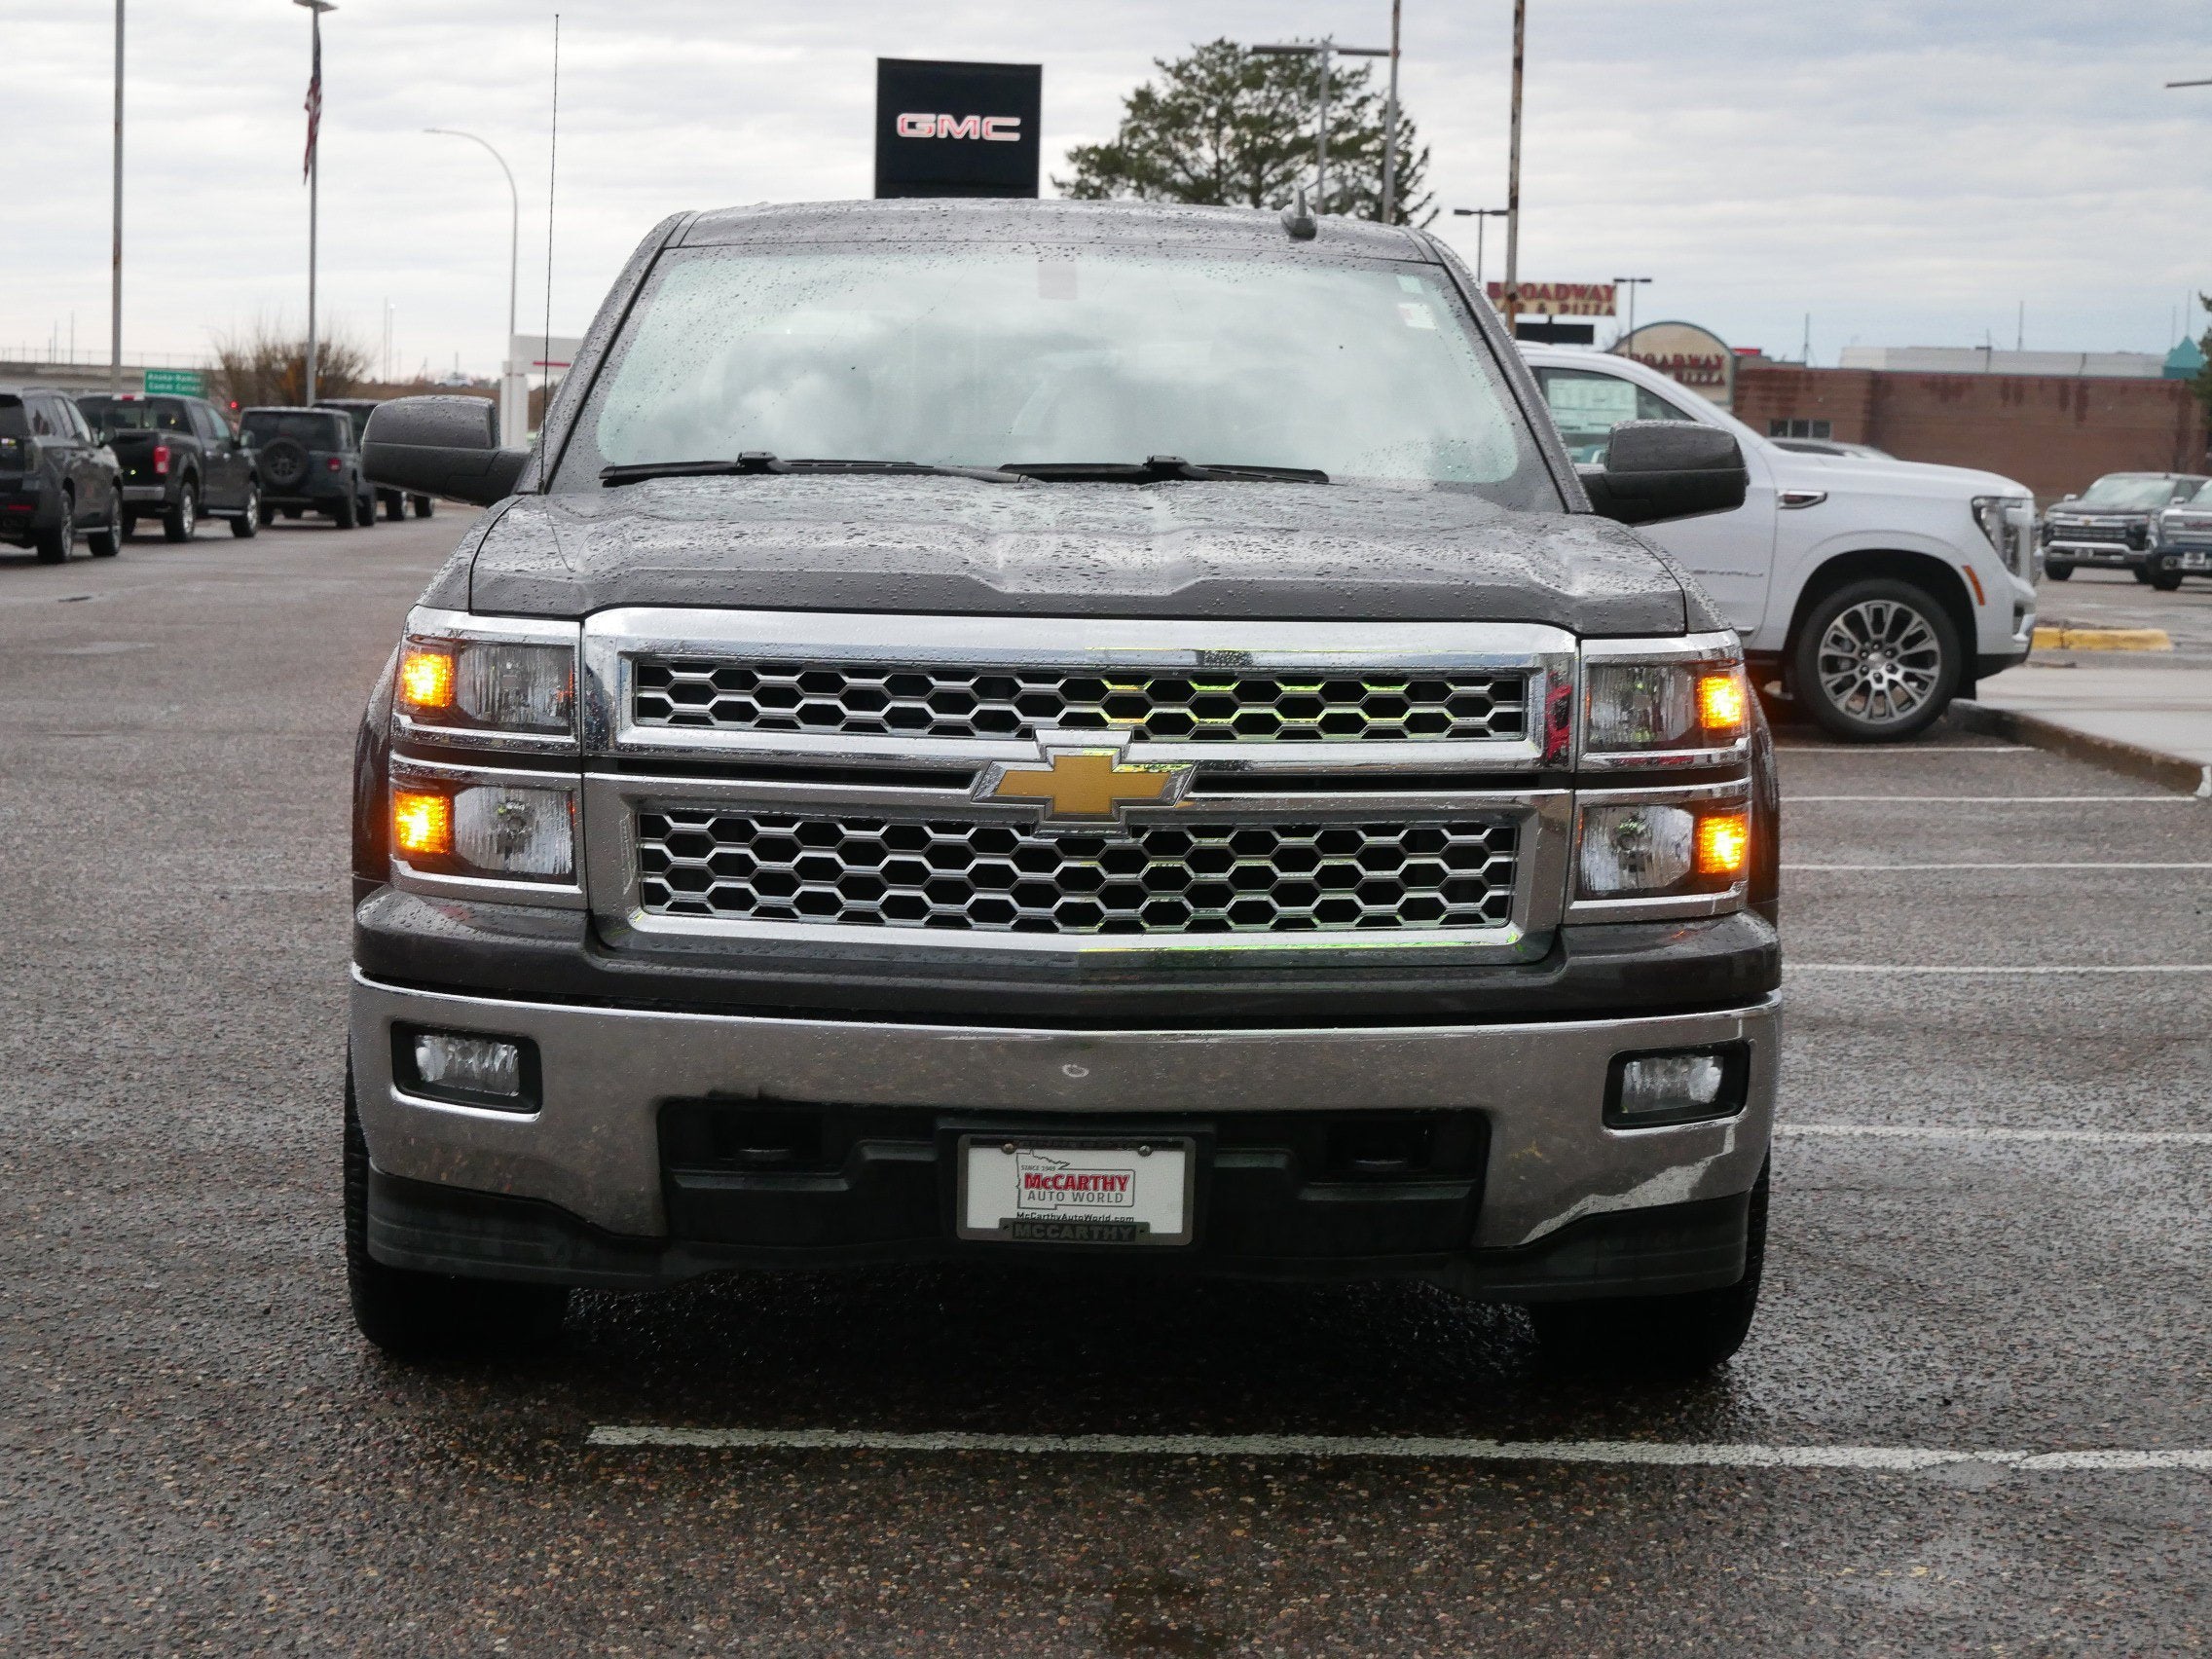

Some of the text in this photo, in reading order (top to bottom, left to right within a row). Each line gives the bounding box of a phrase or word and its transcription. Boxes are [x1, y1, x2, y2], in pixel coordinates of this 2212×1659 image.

[897, 113, 1021, 141] GMC
[1559, 303, 1616, 315] PIZZA
[1024, 1173, 1130, 1192] McCARTHY
[1027, 1191, 1124, 1203] AUTO WORLD
